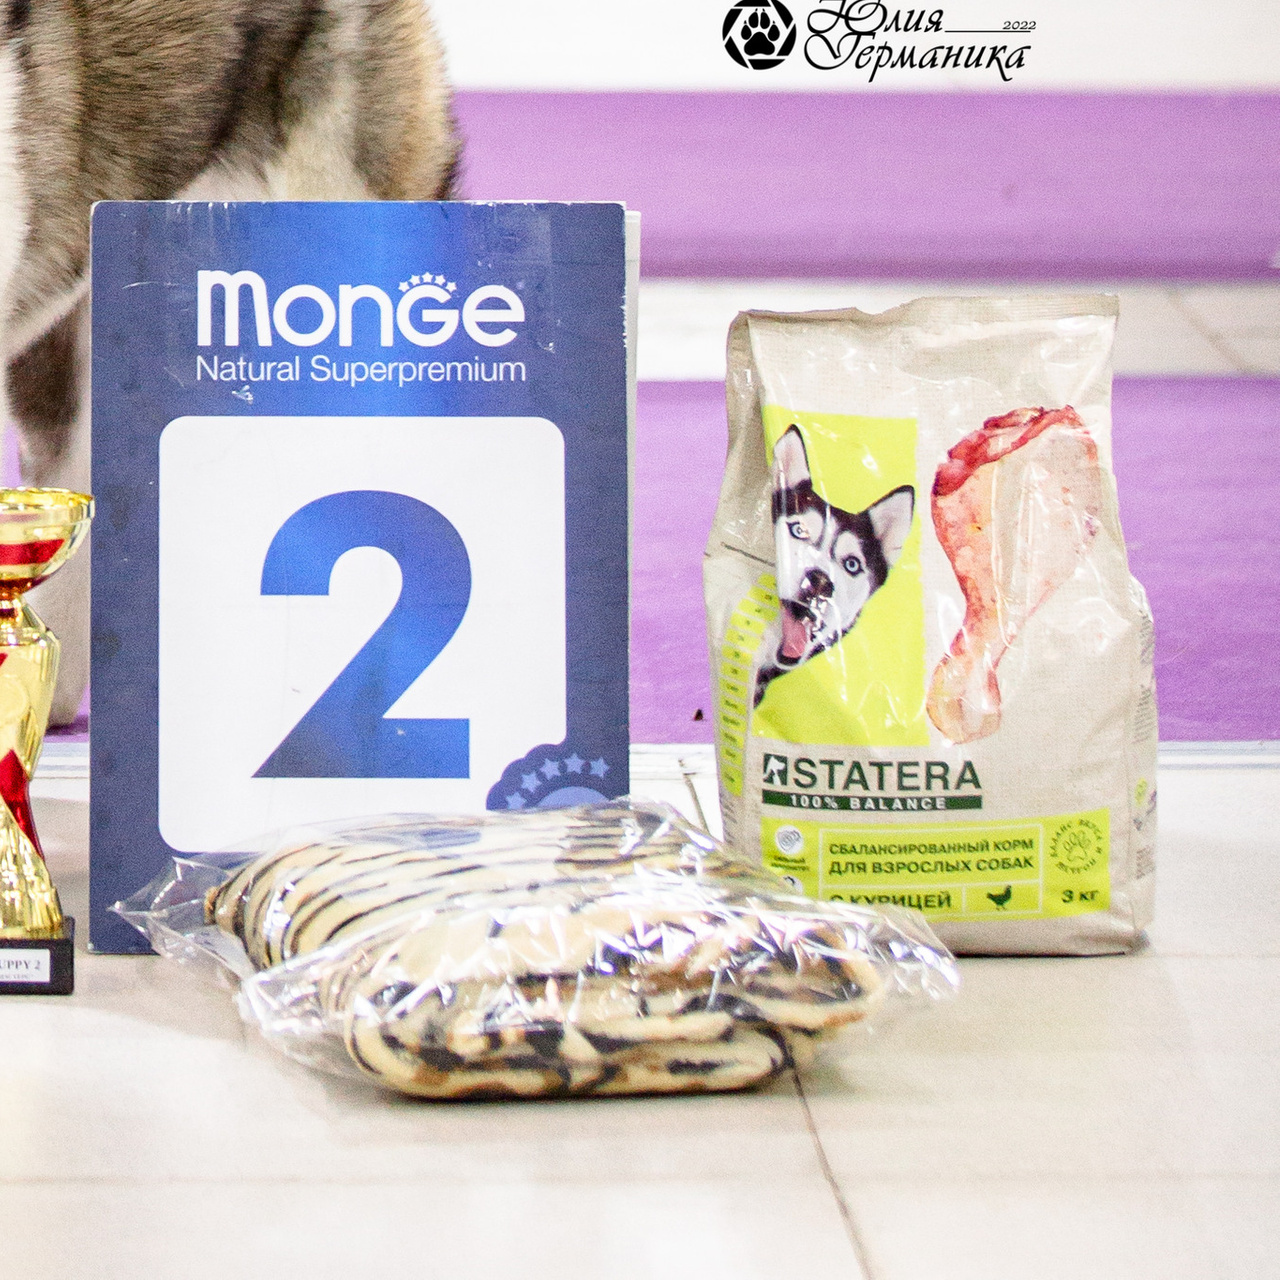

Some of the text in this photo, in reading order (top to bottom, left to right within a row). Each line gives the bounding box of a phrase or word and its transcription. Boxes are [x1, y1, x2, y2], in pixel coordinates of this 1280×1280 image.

[196, 355, 526, 387] Natural Superpremium
[251, 489, 473, 780] 2
[793, 757, 982, 791] STATERA
[790, 794, 947, 811] 100% BALANCE
[829, 838, 1034, 855] СБАЛАНСИРОВАННЫЙ КОРМ
[829, 856, 1035, 875] ДЛЯ ВЗРОСЛЫХ СОБАК
[1061, 890, 1074, 904] 3
[34, 959, 41, 970] 2
